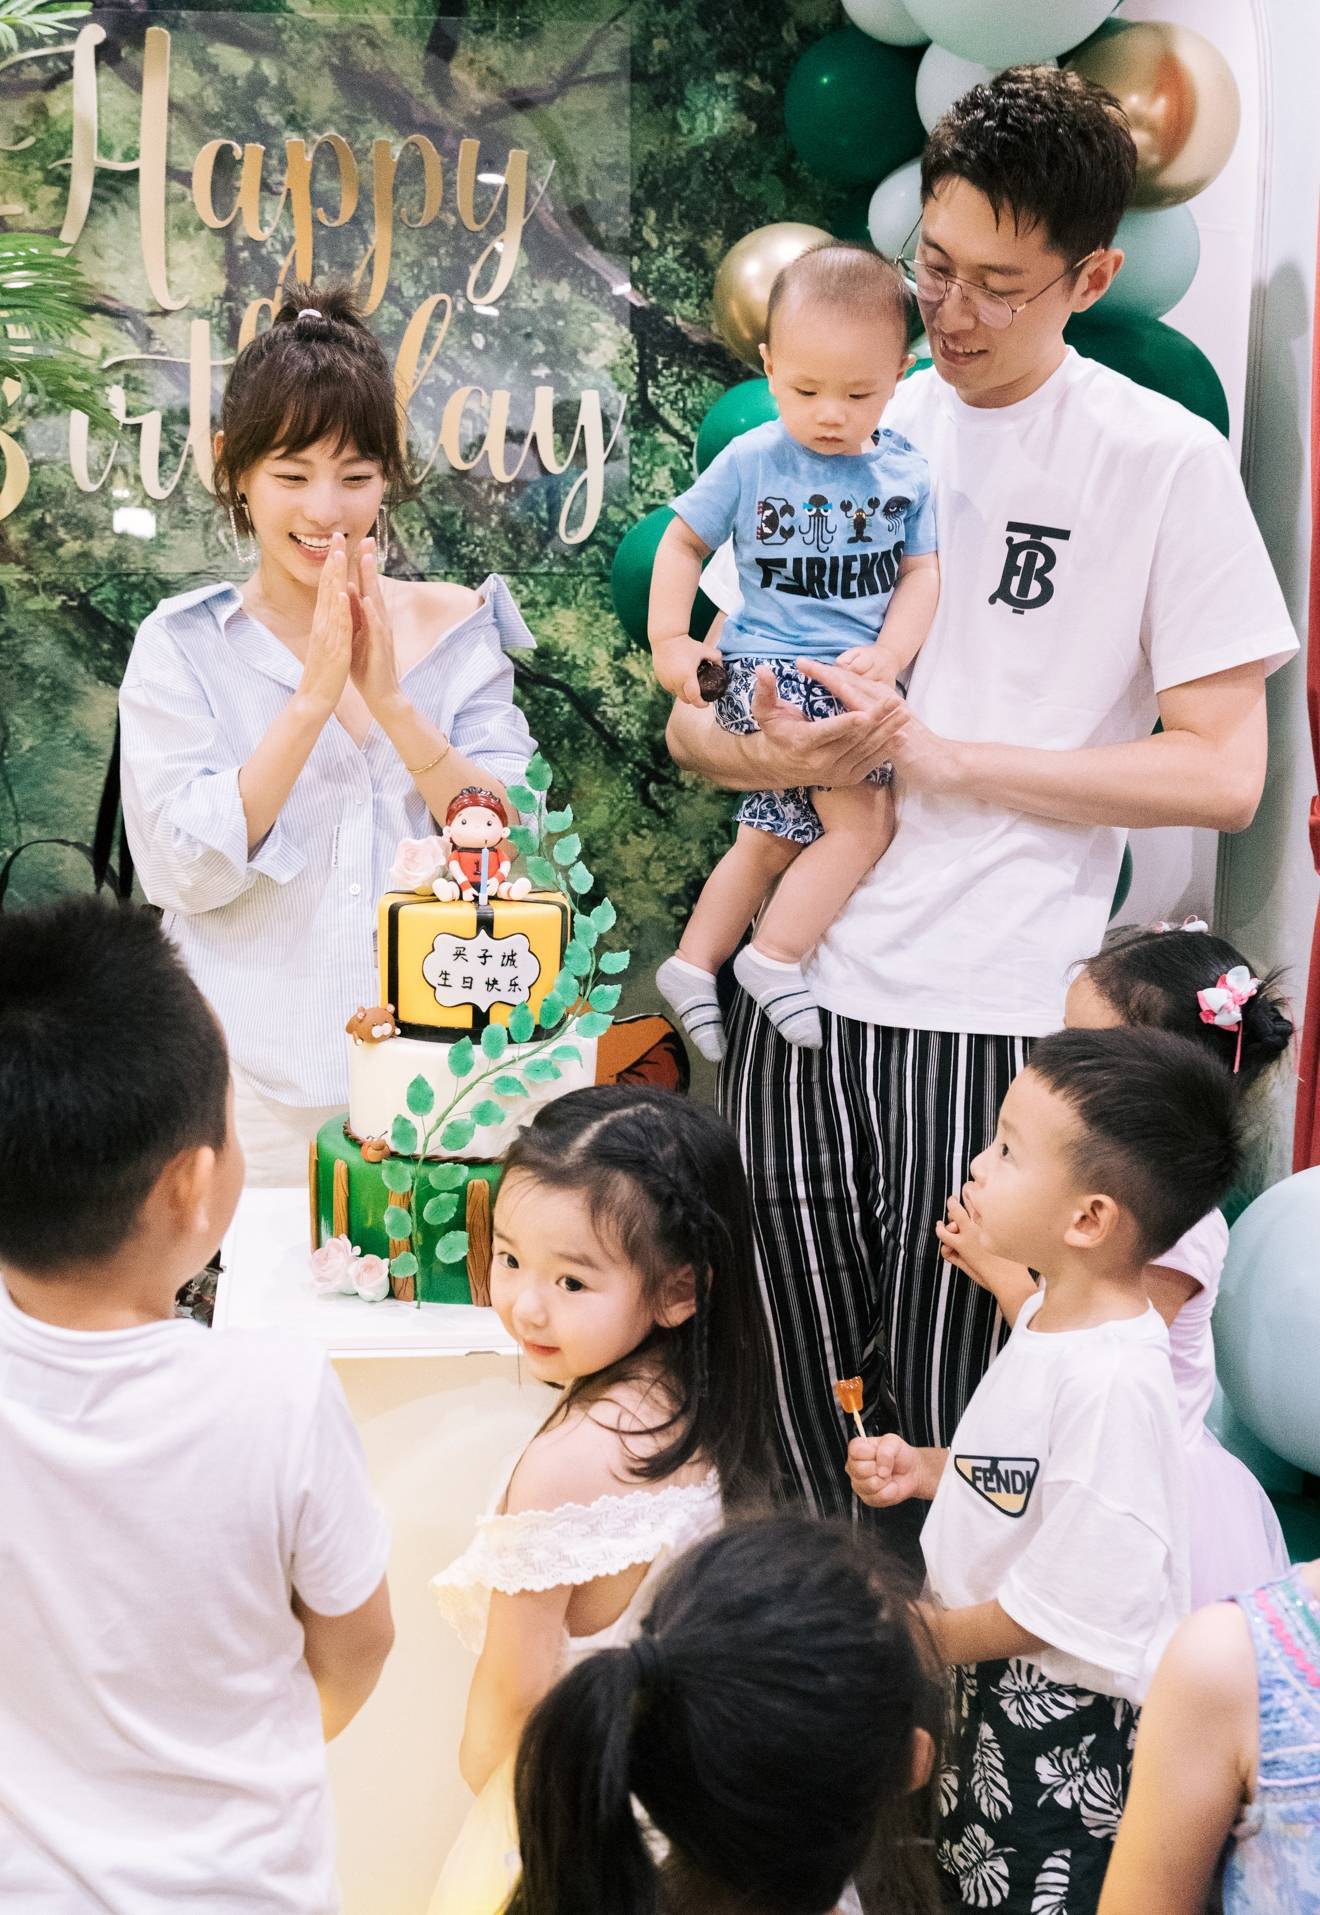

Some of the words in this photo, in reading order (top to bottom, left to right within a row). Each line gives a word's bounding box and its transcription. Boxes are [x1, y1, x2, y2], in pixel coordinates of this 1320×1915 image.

[437, 970, 522, 993] 生日快乐
[971, 1465, 1034, 1495] FENDI
